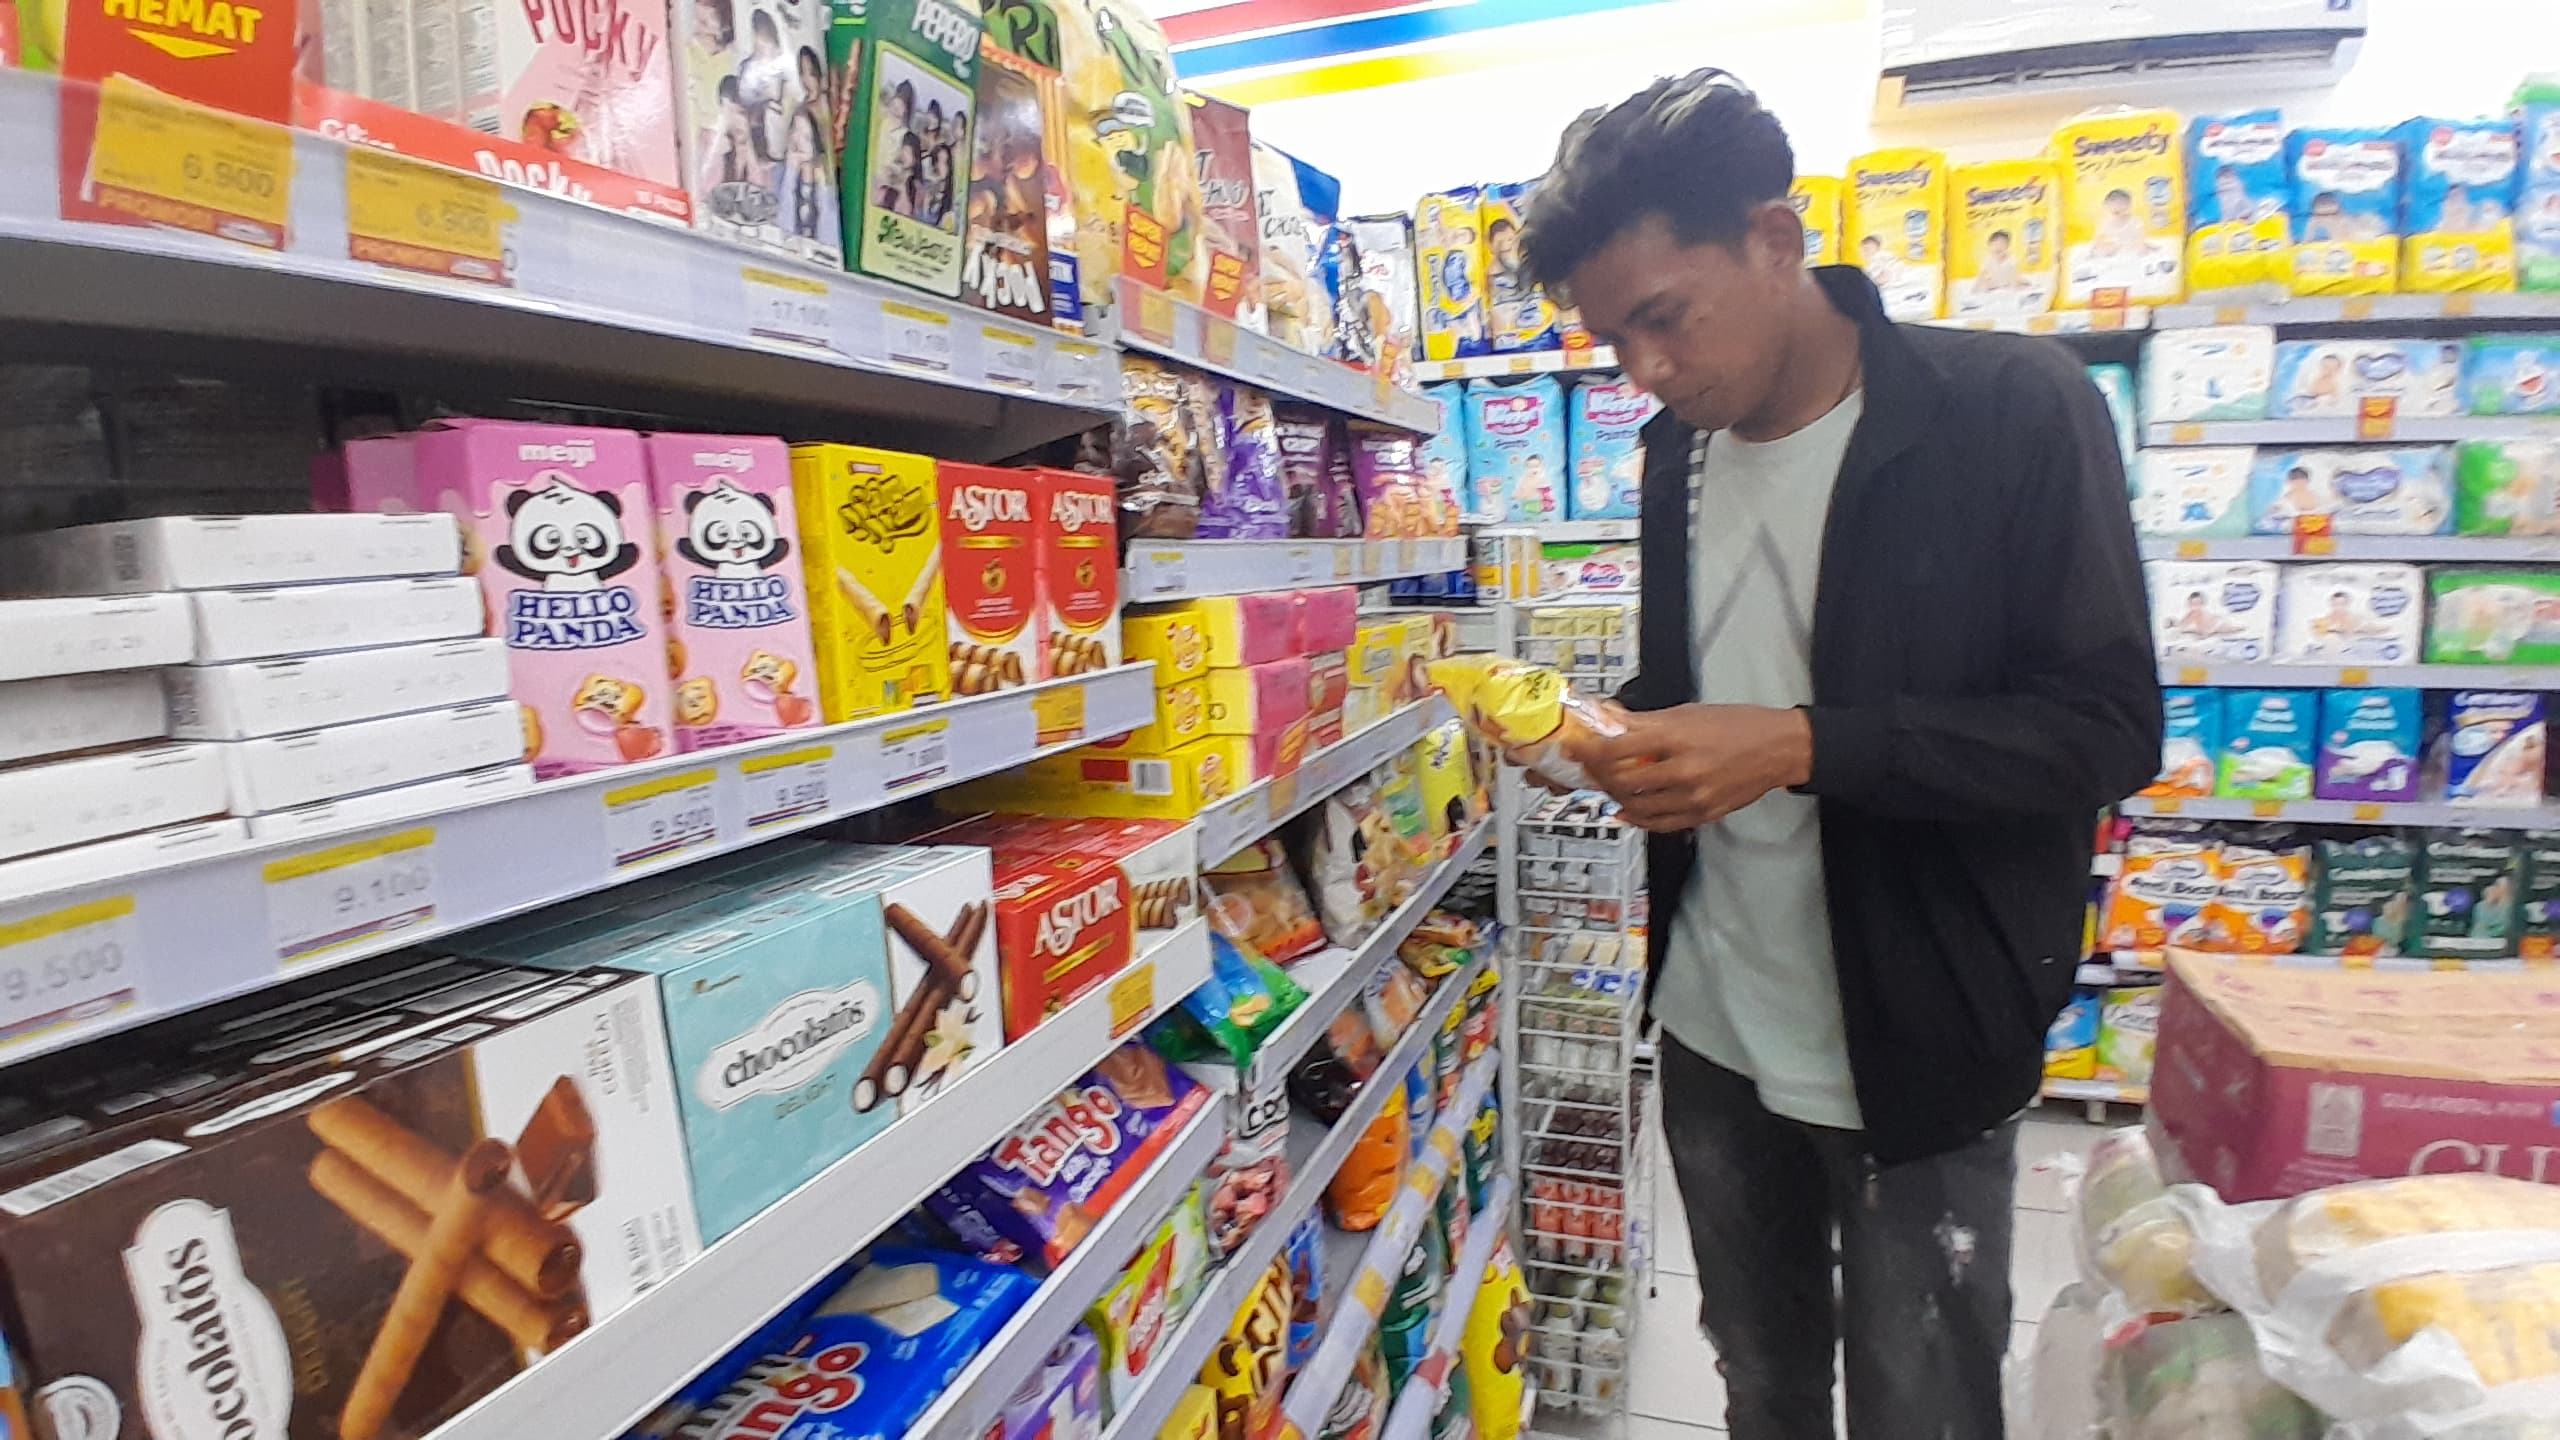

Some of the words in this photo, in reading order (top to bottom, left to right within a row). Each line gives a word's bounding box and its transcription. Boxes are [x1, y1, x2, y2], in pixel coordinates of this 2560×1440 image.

[102, 0, 264, 44] HEMAT
[2073, 126, 2170, 157] Sweety
[947, 484, 1032, 533] ASTOR
[1049, 490, 1115, 533] ASTOR
[518, 590, 633, 620] HELLO
[694, 576, 787, 603] HELLO
[514, 615, 646, 647] PANDA
[691, 601, 794, 625] PANDA
[1030, 877, 1123, 959] ASTOR
[993, 1085, 1123, 1187] Tango
[722, 1342, 870, 1440] ngo
